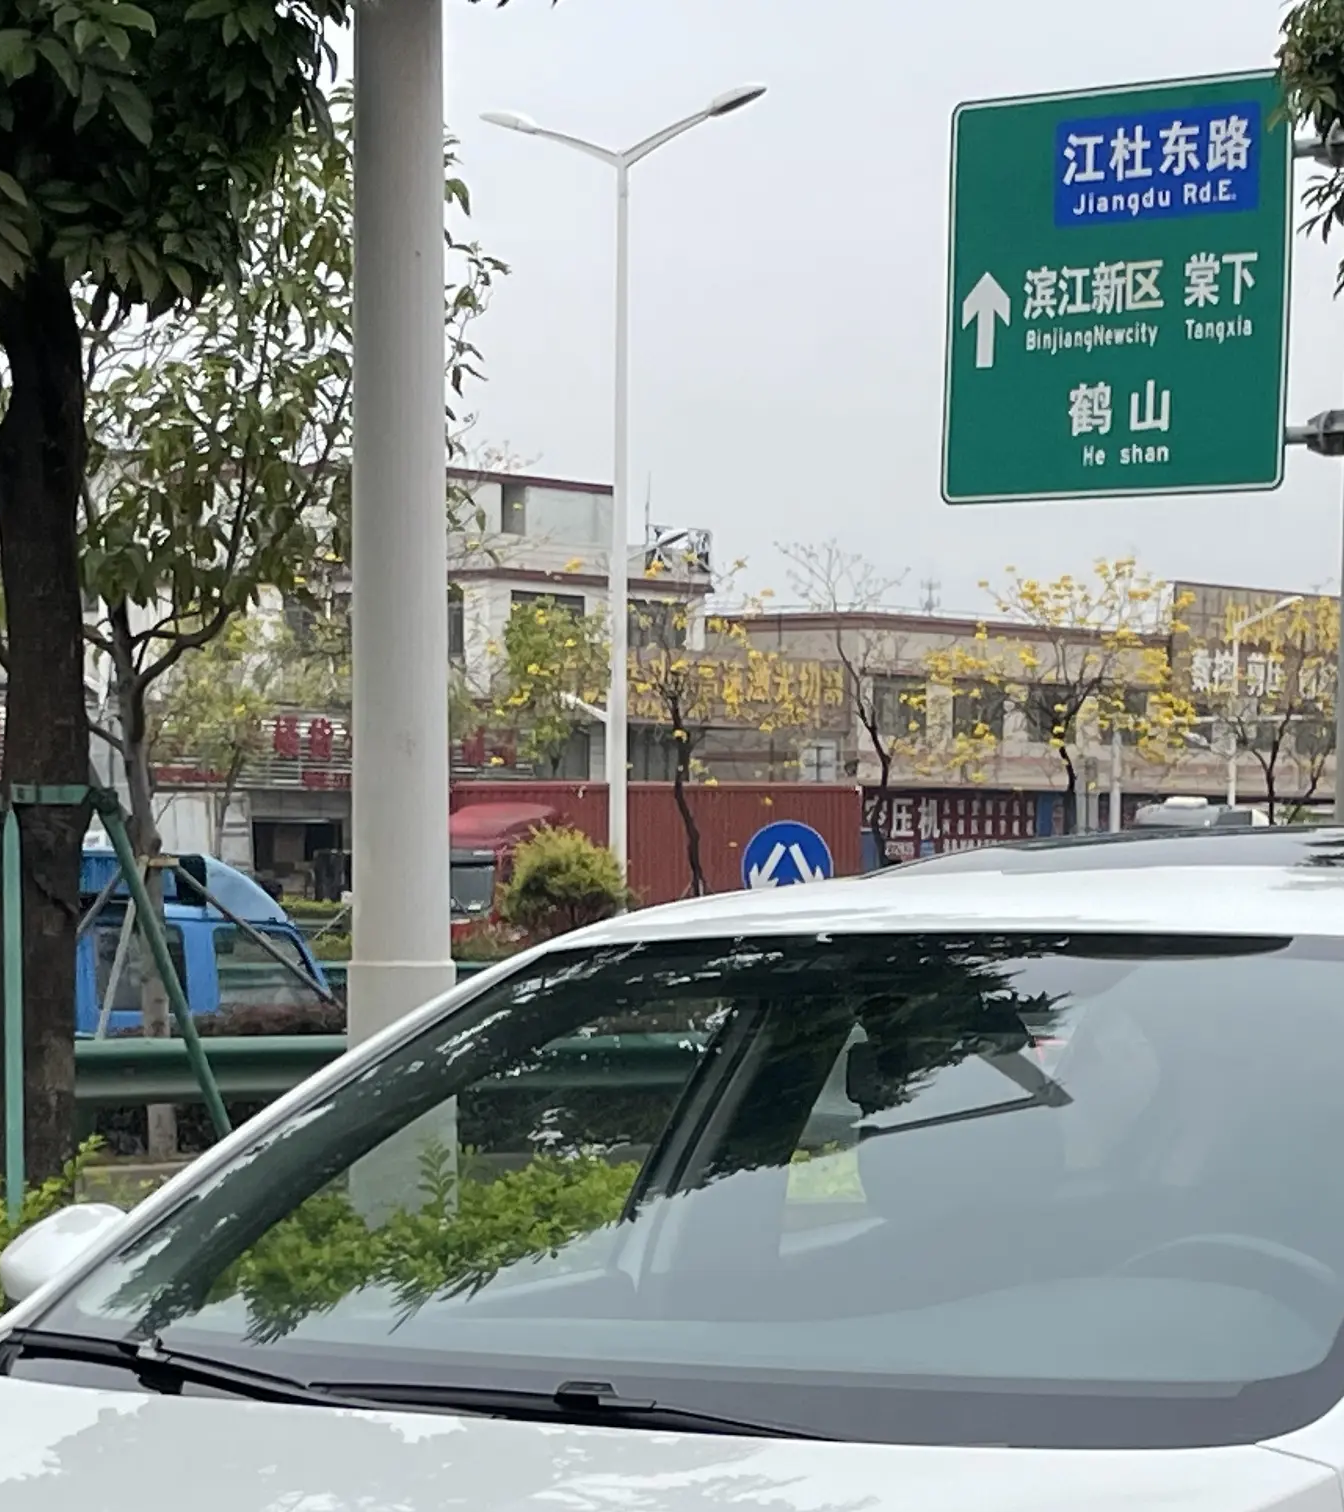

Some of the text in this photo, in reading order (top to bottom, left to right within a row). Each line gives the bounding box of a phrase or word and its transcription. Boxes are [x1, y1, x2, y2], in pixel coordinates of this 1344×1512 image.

[1063, 115, 1252, 186] 江杜东路
[1072, 186, 1171, 217] Jiangdu
[1023, 252, 1258, 320] 滨江新区 棠下
[1185, 315, 1253, 344] Tangxia
[1068, 379, 1171, 437] 鹤山
[1083, 443, 1170, 467] He shan
